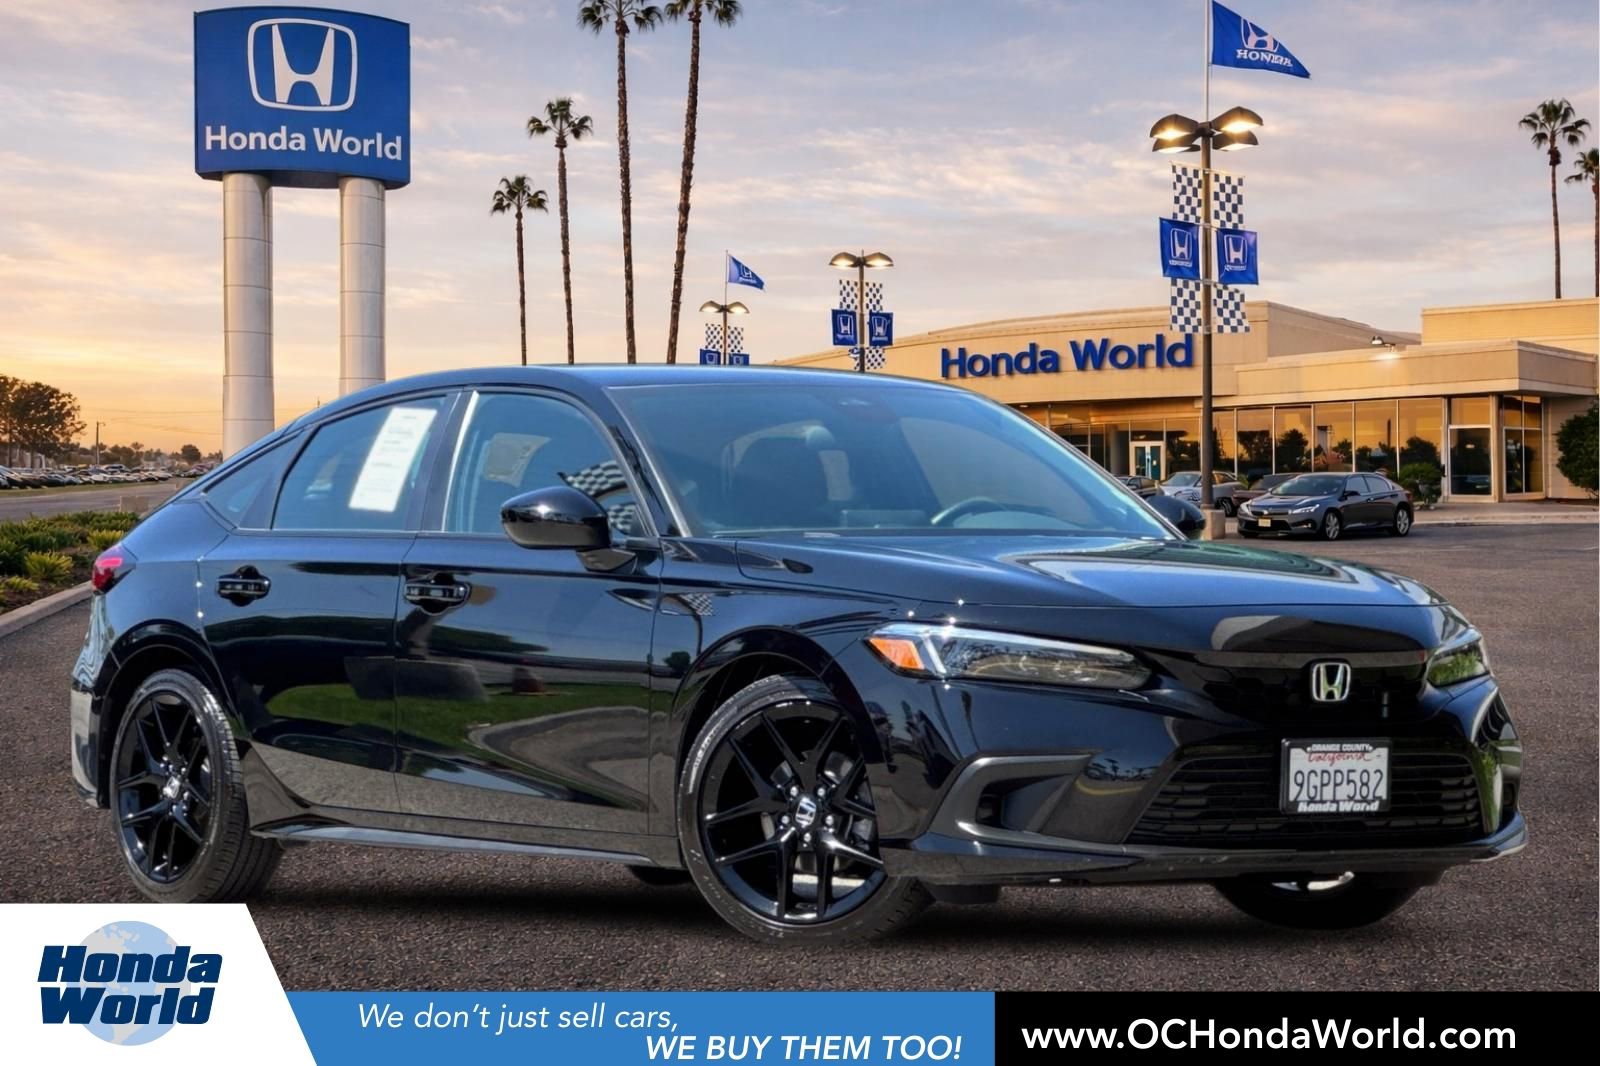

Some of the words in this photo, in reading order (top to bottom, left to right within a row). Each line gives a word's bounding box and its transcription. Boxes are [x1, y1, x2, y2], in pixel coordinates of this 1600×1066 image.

[204, 124, 307, 153] Honda
[313, 126, 403, 162] World
[940, 342, 1061, 379] Honda
[1069, 332, 1194, 371] World
[1294, 769, 1384, 801] 9GPP582
[1297, 800, 1338, 813] Honda
